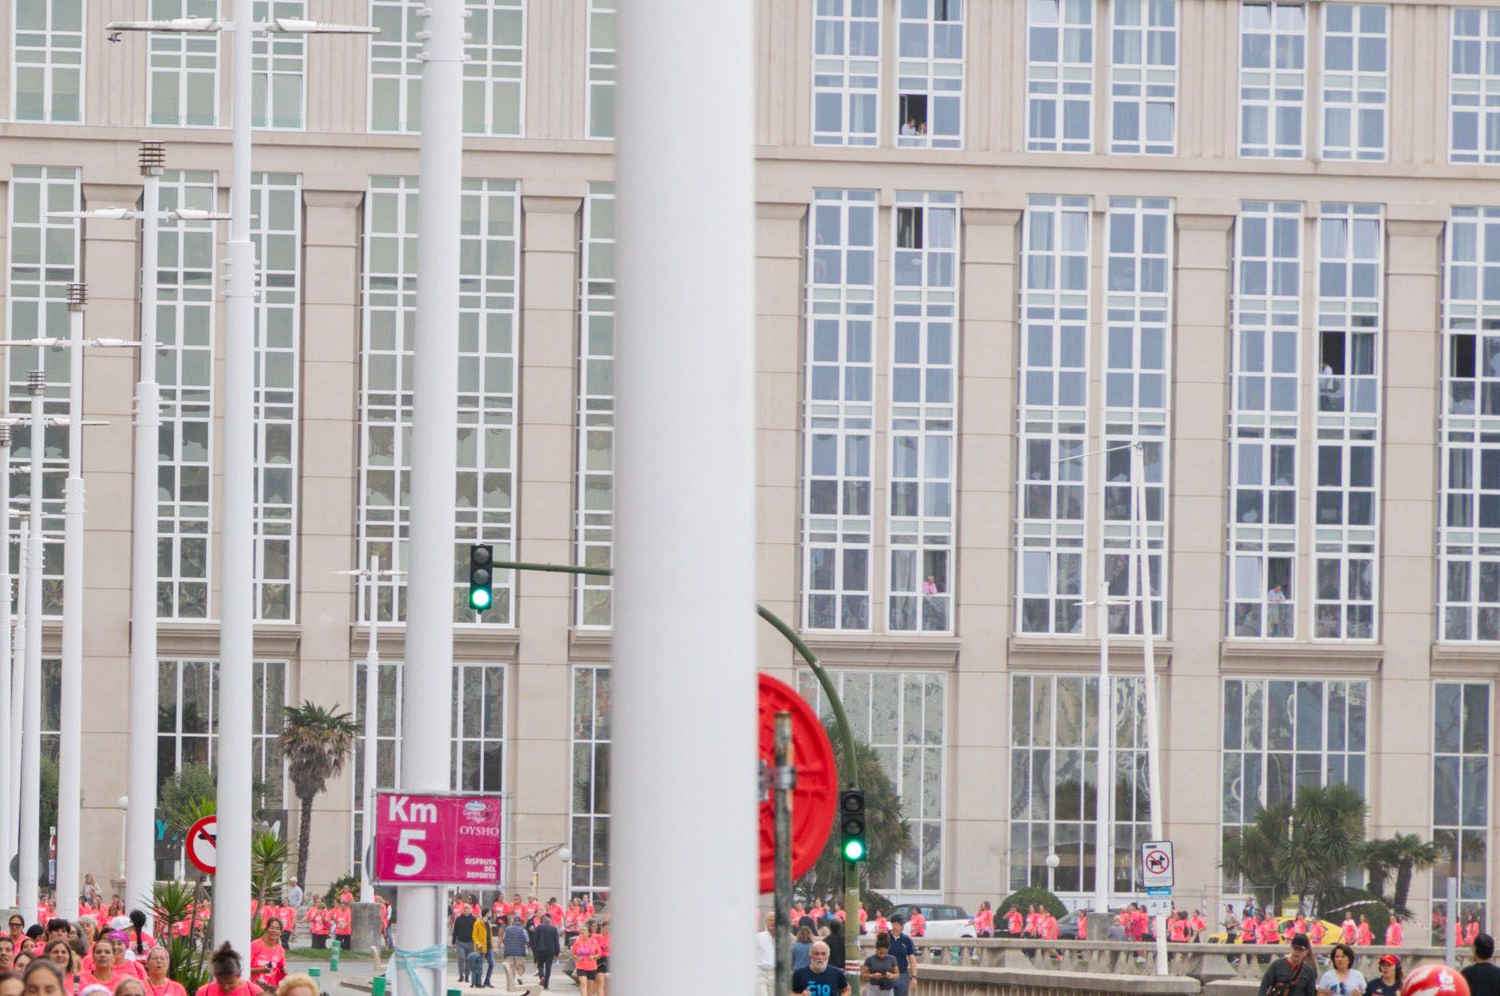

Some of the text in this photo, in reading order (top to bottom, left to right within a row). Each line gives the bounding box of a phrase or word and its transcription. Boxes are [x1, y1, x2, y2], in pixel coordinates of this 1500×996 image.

[388, 796, 437, 823] Km
[460, 825, 500, 836] OYSHO
[393, 829, 427, 877] 5
[465, 857, 497, 866] DISFRUTA
[466, 871, 496, 879] DEPORTE
